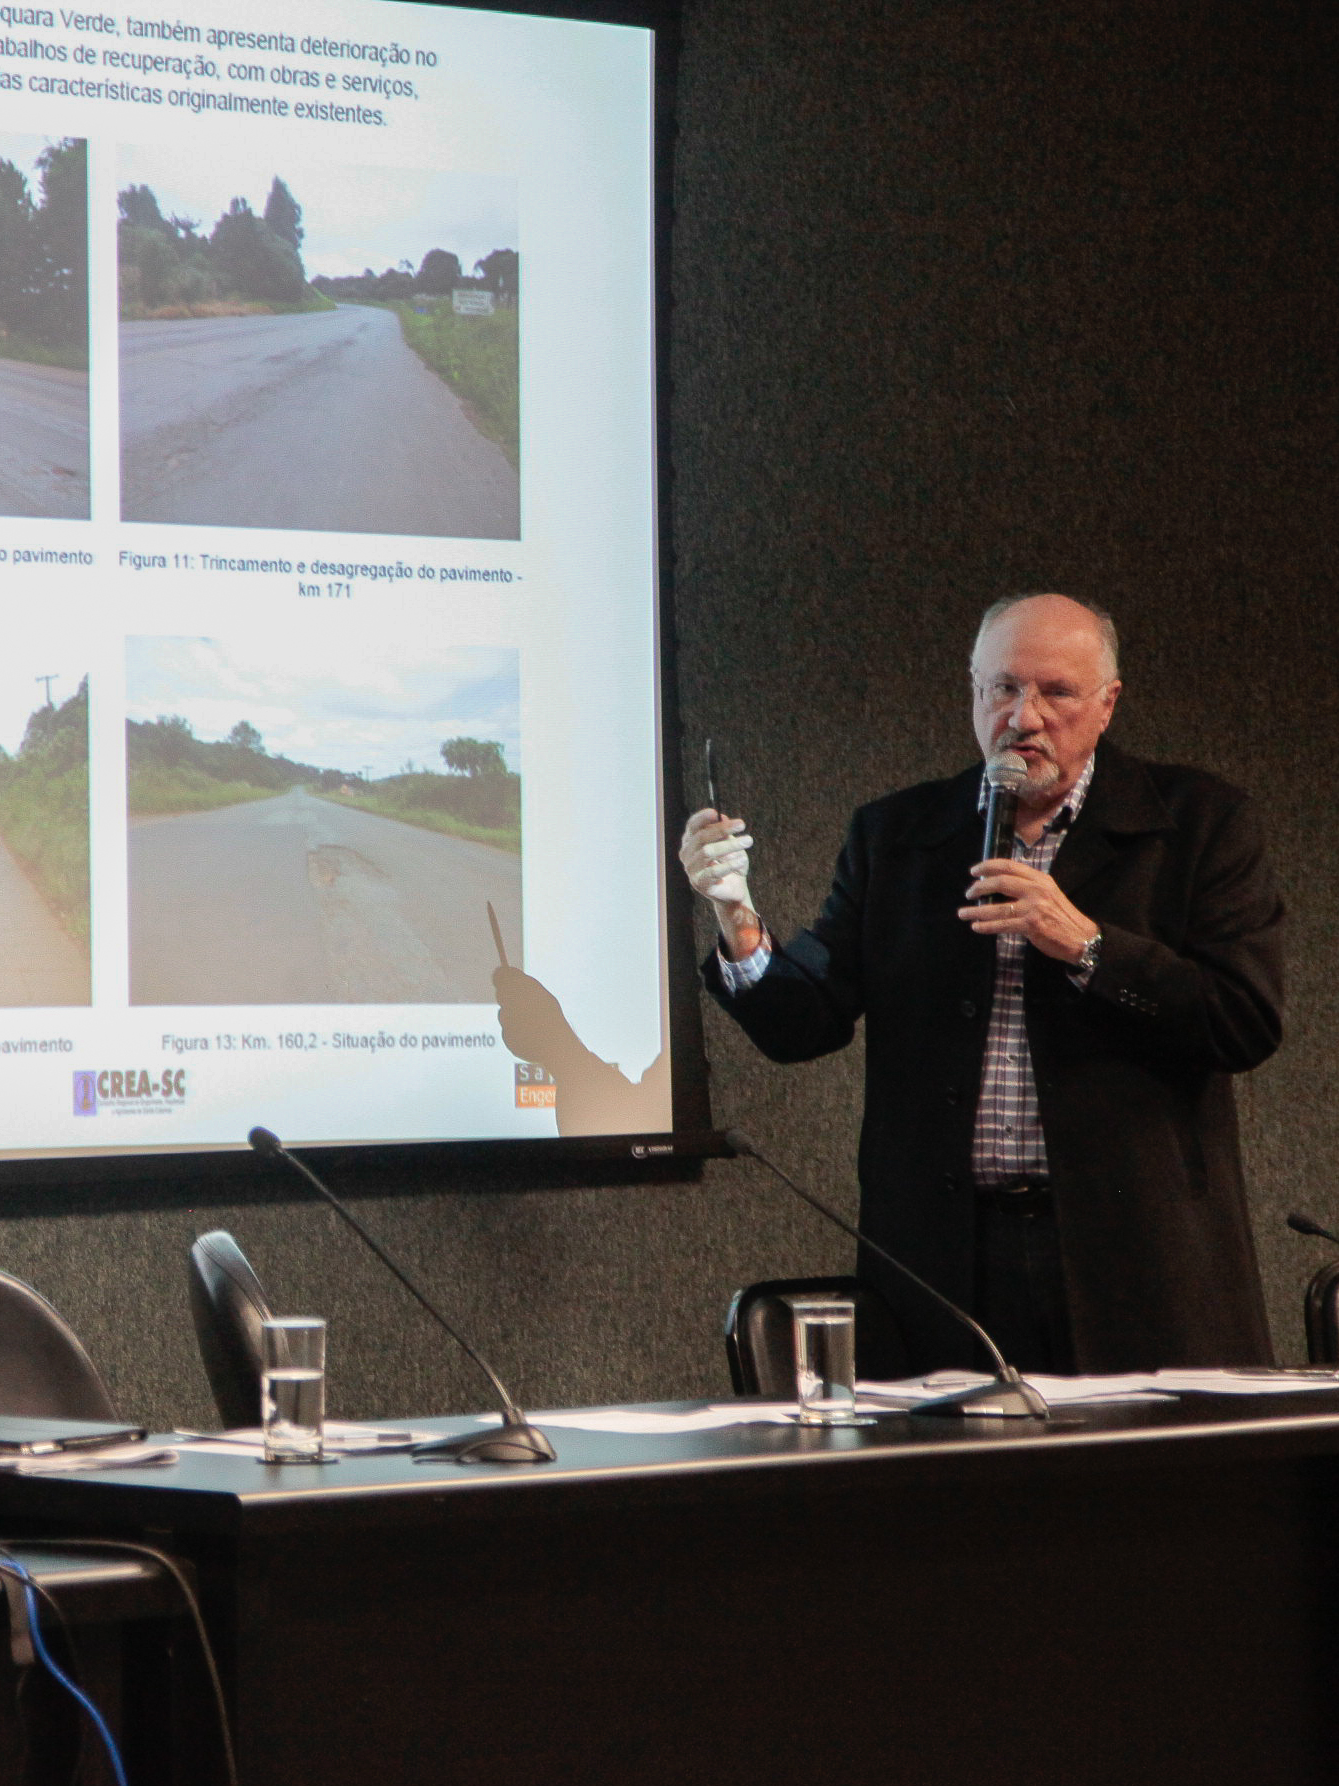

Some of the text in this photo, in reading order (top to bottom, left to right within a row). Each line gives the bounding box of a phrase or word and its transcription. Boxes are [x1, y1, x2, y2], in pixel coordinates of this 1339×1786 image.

[59, 9, 121, 37] Verde,
[126, 16, 201, 43] também
[206, 28, 296, 53] apresenta
[299, 33, 411, 68] deterioração
[415, 50, 438, 68] no
[72, 44, 97, 65] de
[102, 50, 221, 81] recuperação,
[227, 62, 266, 82] com
[269, 65, 321, 88] obras
[324, 74, 337, 90] e
[341, 74, 420, 100] serviços,
[28, 75, 163, 105] características
[167, 88, 289, 117] originalmente
[293, 101, 388, 127] existentes.
[12, 548, 93, 566] pavimento
[118, 550, 167, 571] Figura
[172, 552, 195, 570] 11:
[199, 553, 293, 575] Trincamento
[296, 561, 306, 575] e
[310, 559, 414, 583] desagregação
[417, 564, 436, 581] do
[439, 566, 513, 584] pavimento
[298, 581, 352, 599] km 171
[161, 1034, 210, 1054] Figura
[215, 1034, 238, 1051] 13:
[241, 1034, 271, 1050] Km.
[277, 1032, 318, 1052] 160,2
[332, 1031, 396, 1053] Situação
[399, 1032, 418, 1049] do
[421, 1032, 496, 1052] pavimento
[96, 1068, 186, 1099] CREA-SC
